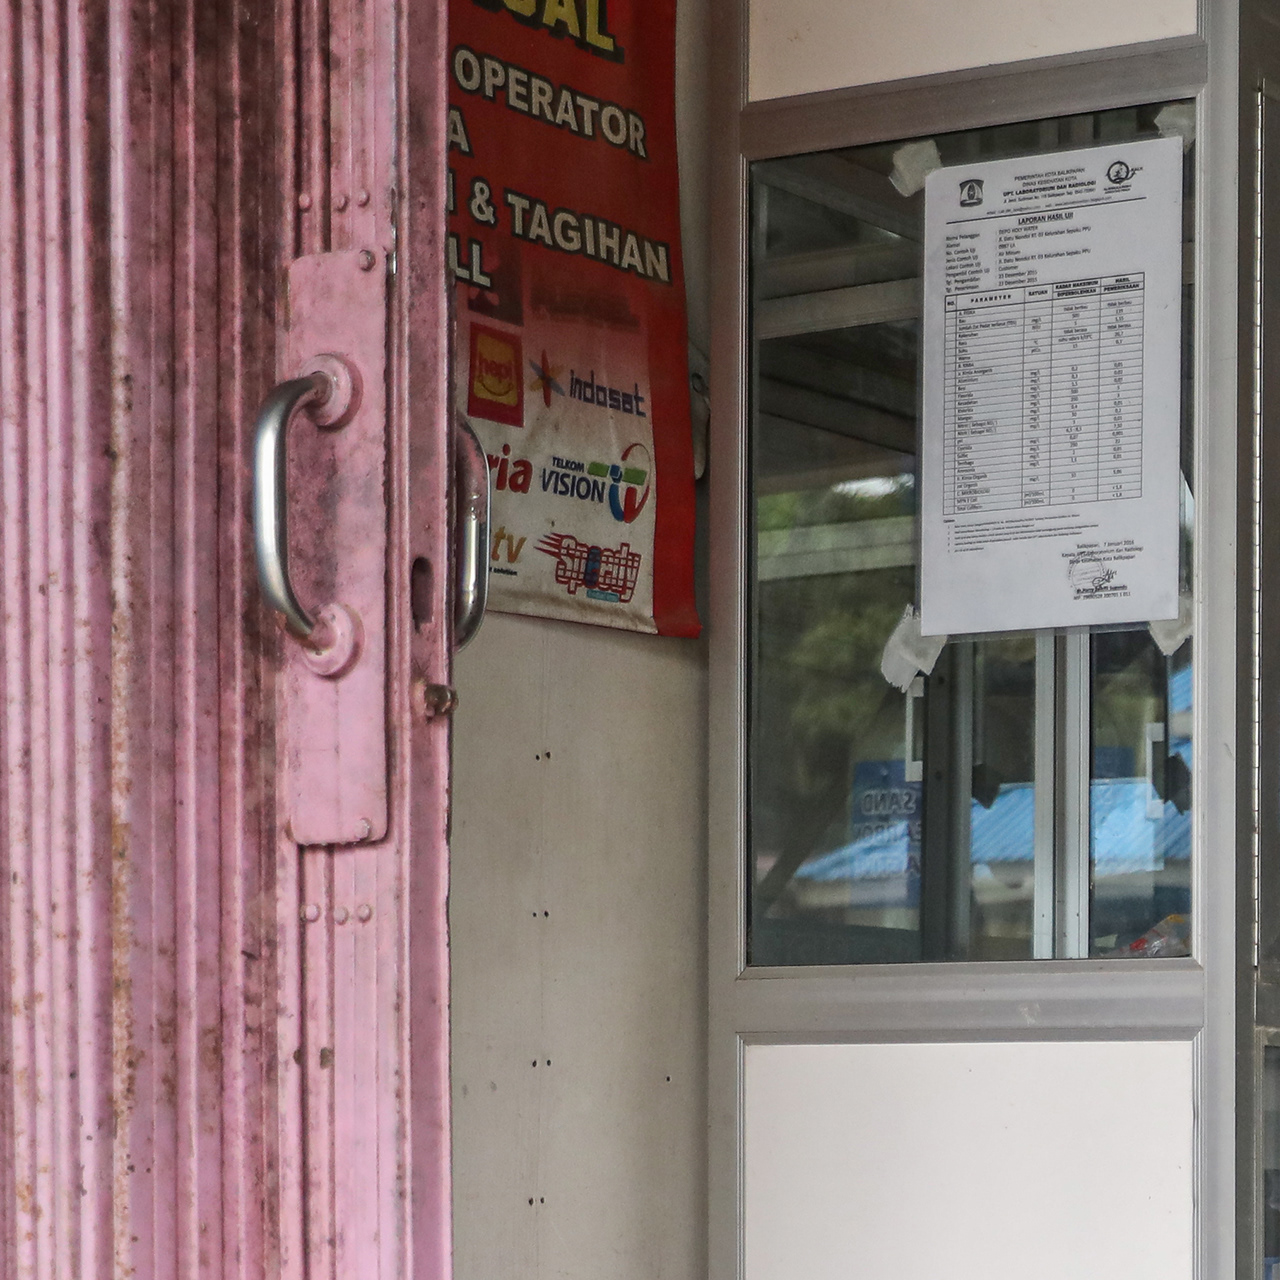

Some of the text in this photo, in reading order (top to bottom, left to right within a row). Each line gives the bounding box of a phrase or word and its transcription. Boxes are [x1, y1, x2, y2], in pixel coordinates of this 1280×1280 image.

[454, 49, 646, 158] OPERATOR
[1015, 185, 1054, 195] LABORATORIUM
[1068, 180, 1095, 188] RADIOLOGI
[471, 181, 495, 224] &
[507, 193, 669, 282] TAGIHAN
[1018, 215, 1046, 224] LAPORAN
[1047, 213, 1063, 221] HASIL
[1103, 283, 1139, 291] PEMERIKSAAN
[570, 369, 646, 417] indosat
[552, 456, 585, 473] TELKOM
[541, 467, 606, 503] VISION
